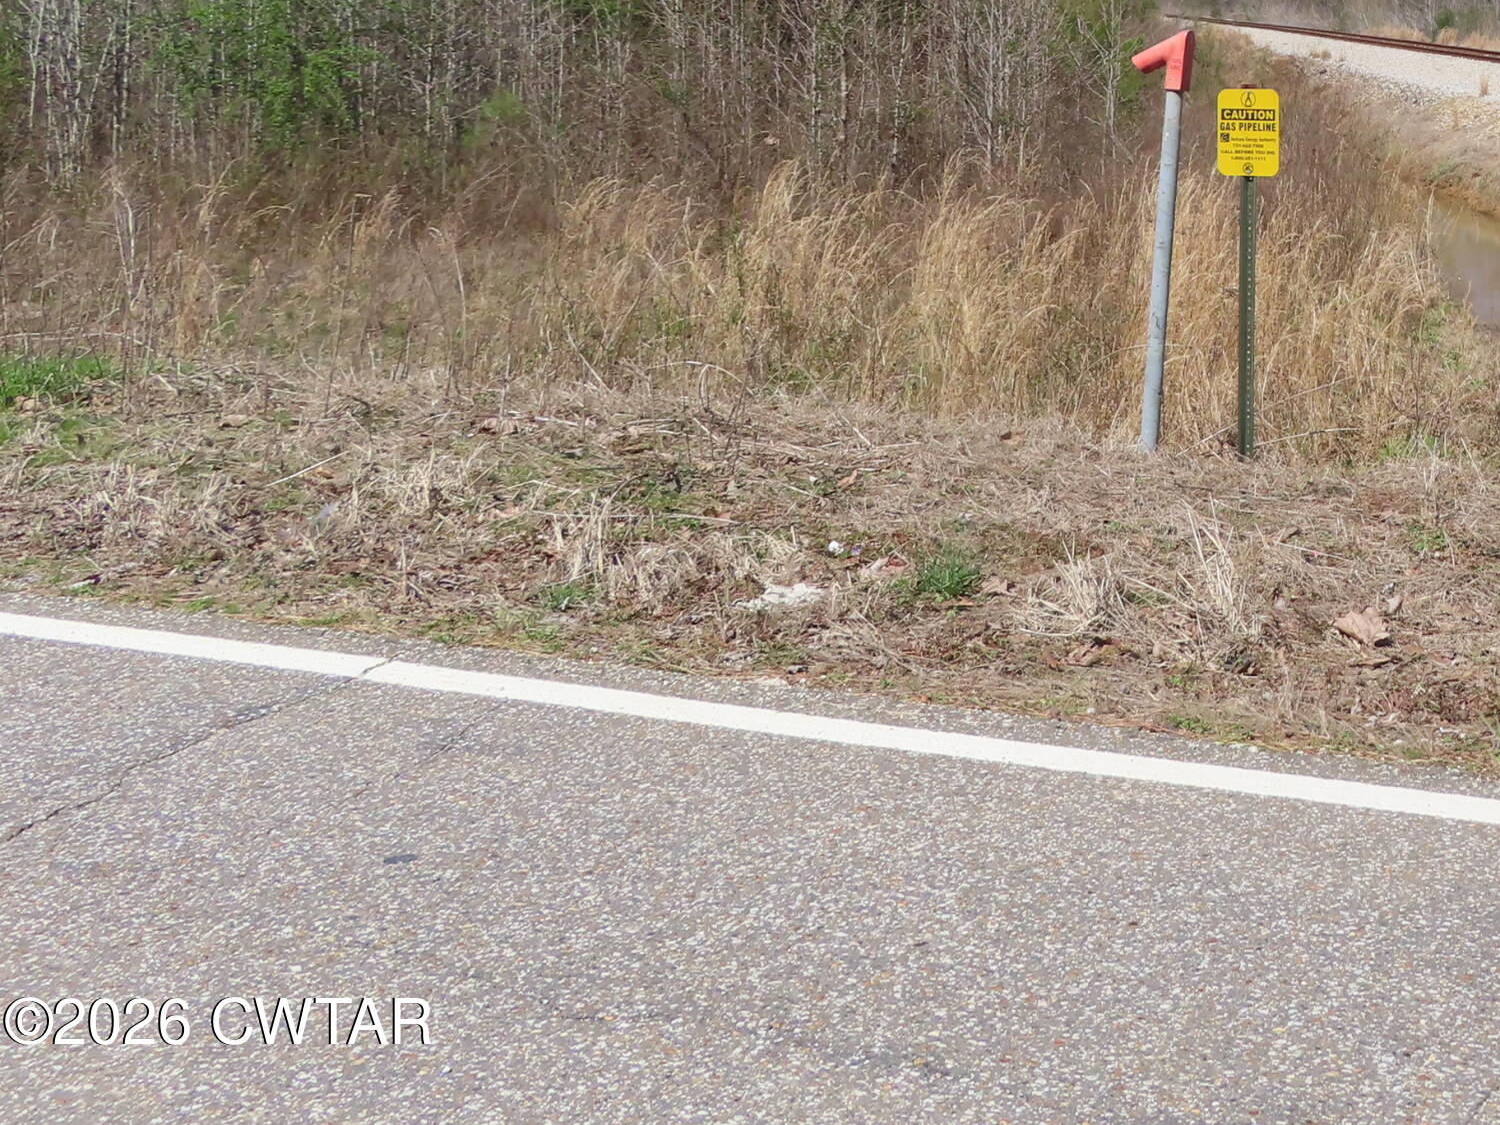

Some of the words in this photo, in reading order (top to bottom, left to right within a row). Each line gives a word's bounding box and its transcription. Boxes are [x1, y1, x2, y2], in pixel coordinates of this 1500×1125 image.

[1223, 109, 1274, 120] CAUTION
[1220, 122, 1236, 131] GAS
[1239, 122, 1276, 131] PIPELINE
